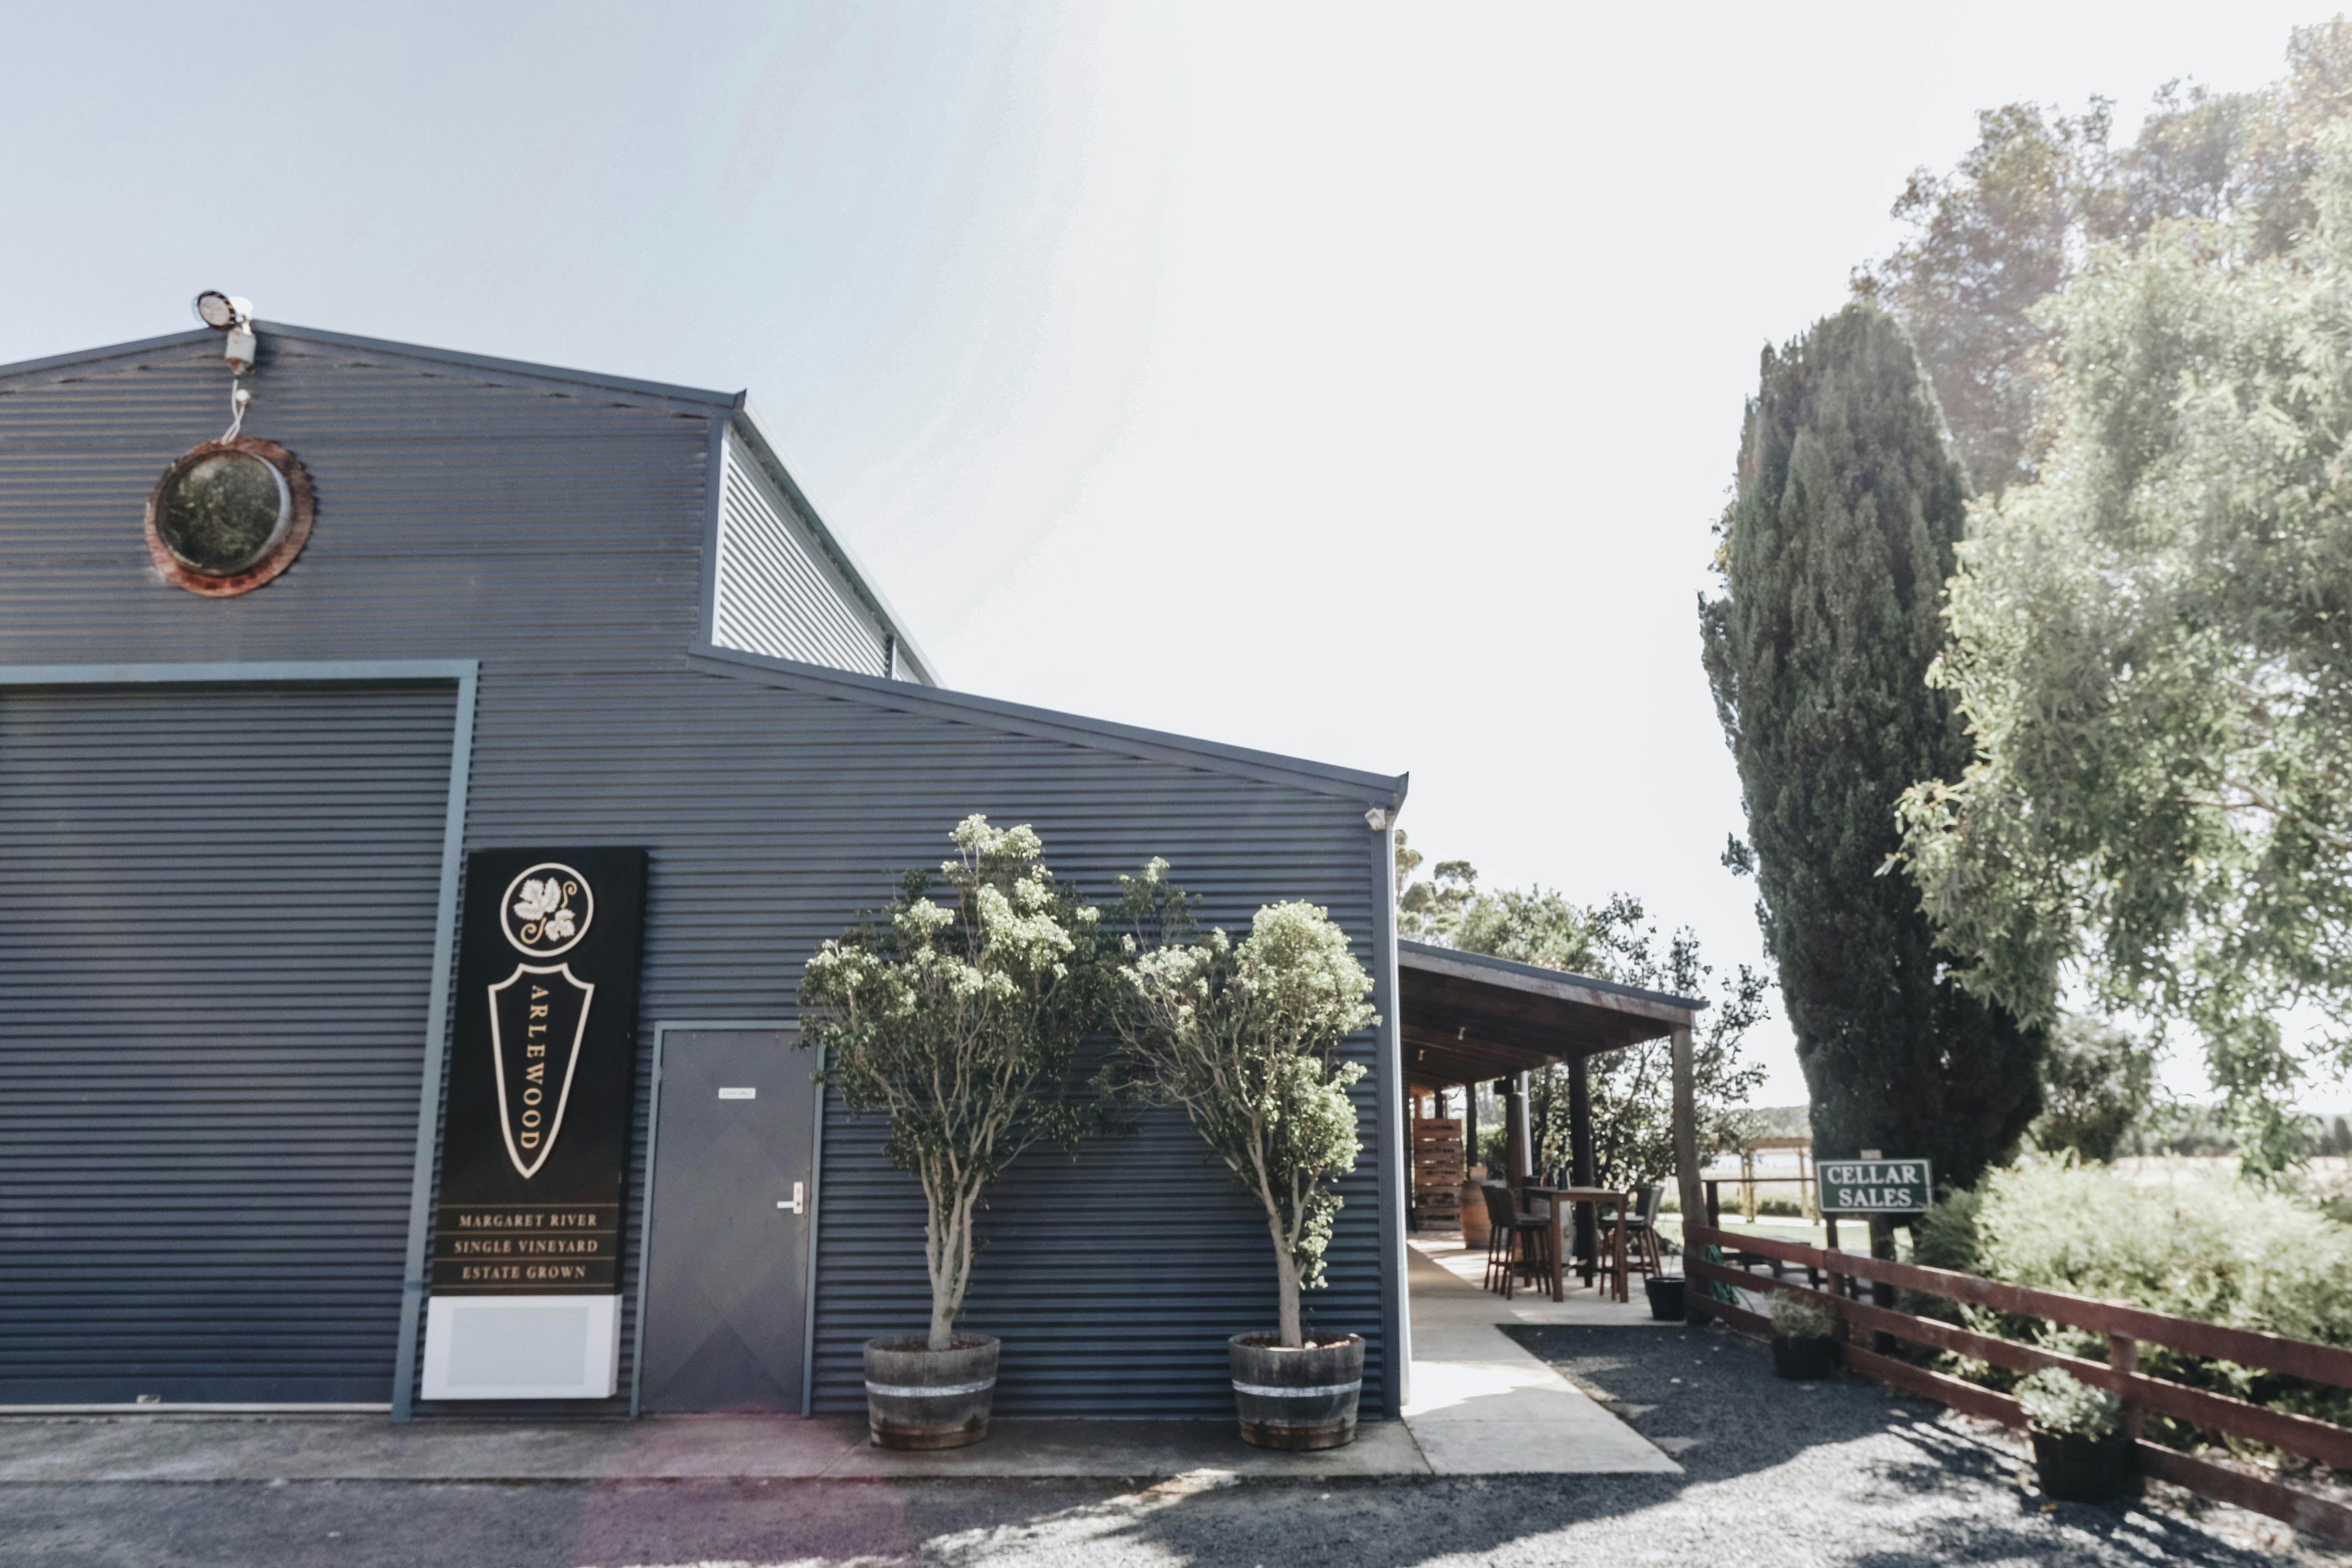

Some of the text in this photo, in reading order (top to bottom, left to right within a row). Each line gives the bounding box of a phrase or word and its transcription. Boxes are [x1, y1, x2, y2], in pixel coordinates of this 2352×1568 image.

[520, 984, 549, 1149] ARLEWOOD
[1827, 1165, 1919, 1184] CELLAR
[1839, 1188, 1912, 1207] SALES
[459, 1214, 597, 1227] MARGARET RIVER
[454, 1240, 598, 1254] SINGLE VINEYARD
[462, 1265, 586, 1279] ESTATE GROWN
